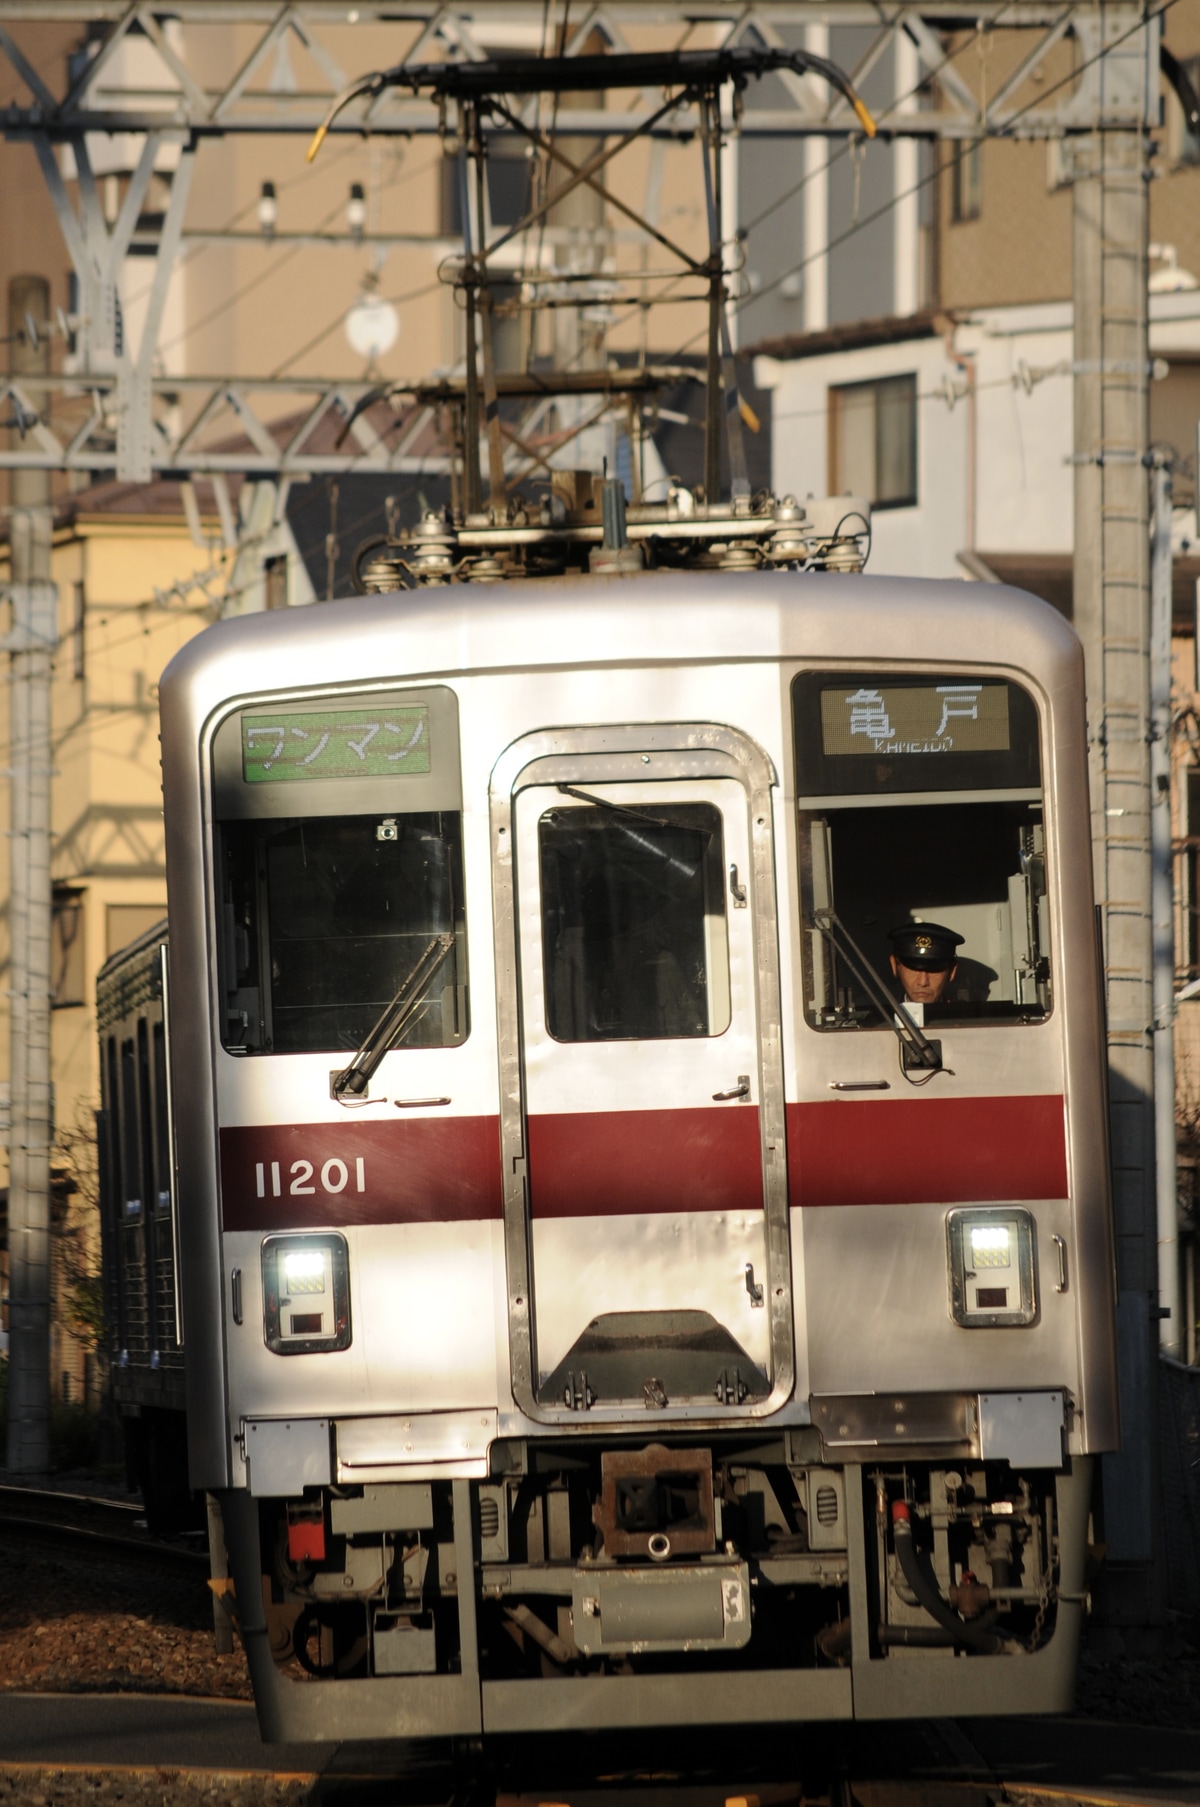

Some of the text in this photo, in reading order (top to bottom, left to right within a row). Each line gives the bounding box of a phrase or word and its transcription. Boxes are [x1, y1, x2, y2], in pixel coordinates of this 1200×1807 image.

[845, 685, 983, 738] 亀戸
[247, 720, 424, 769] ワンマン
[255, 1157, 366, 1198] 11201
